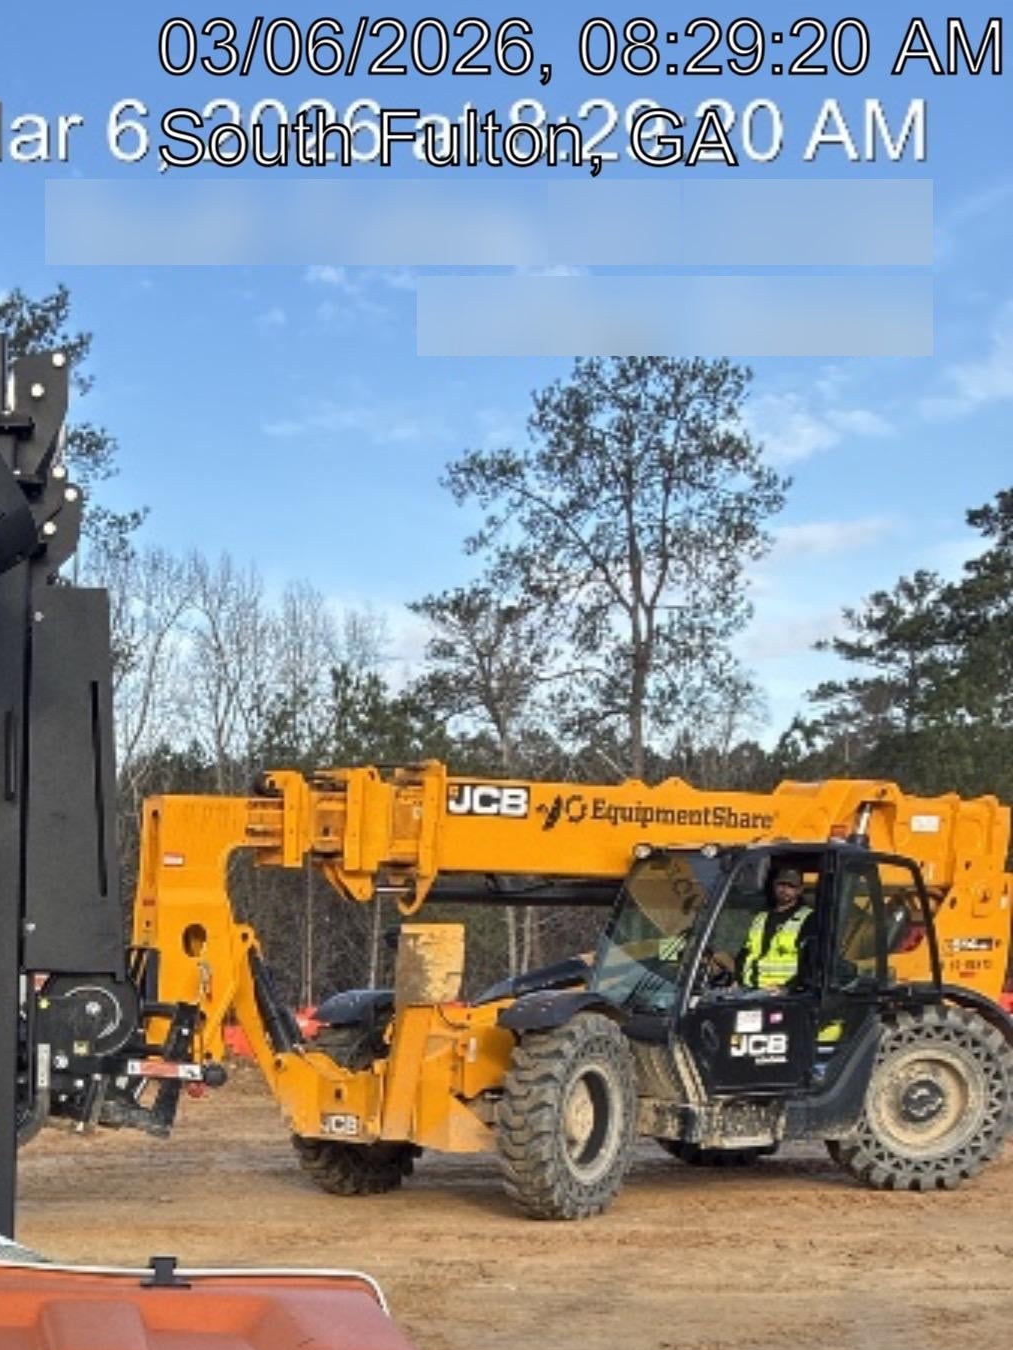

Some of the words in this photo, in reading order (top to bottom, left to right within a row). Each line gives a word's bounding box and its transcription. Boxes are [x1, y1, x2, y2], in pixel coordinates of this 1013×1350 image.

[447, 784, 529, 816] JCB
[590, 799, 773, 830] EquipmentShare
[730, 1032, 788, 1057] JCB
